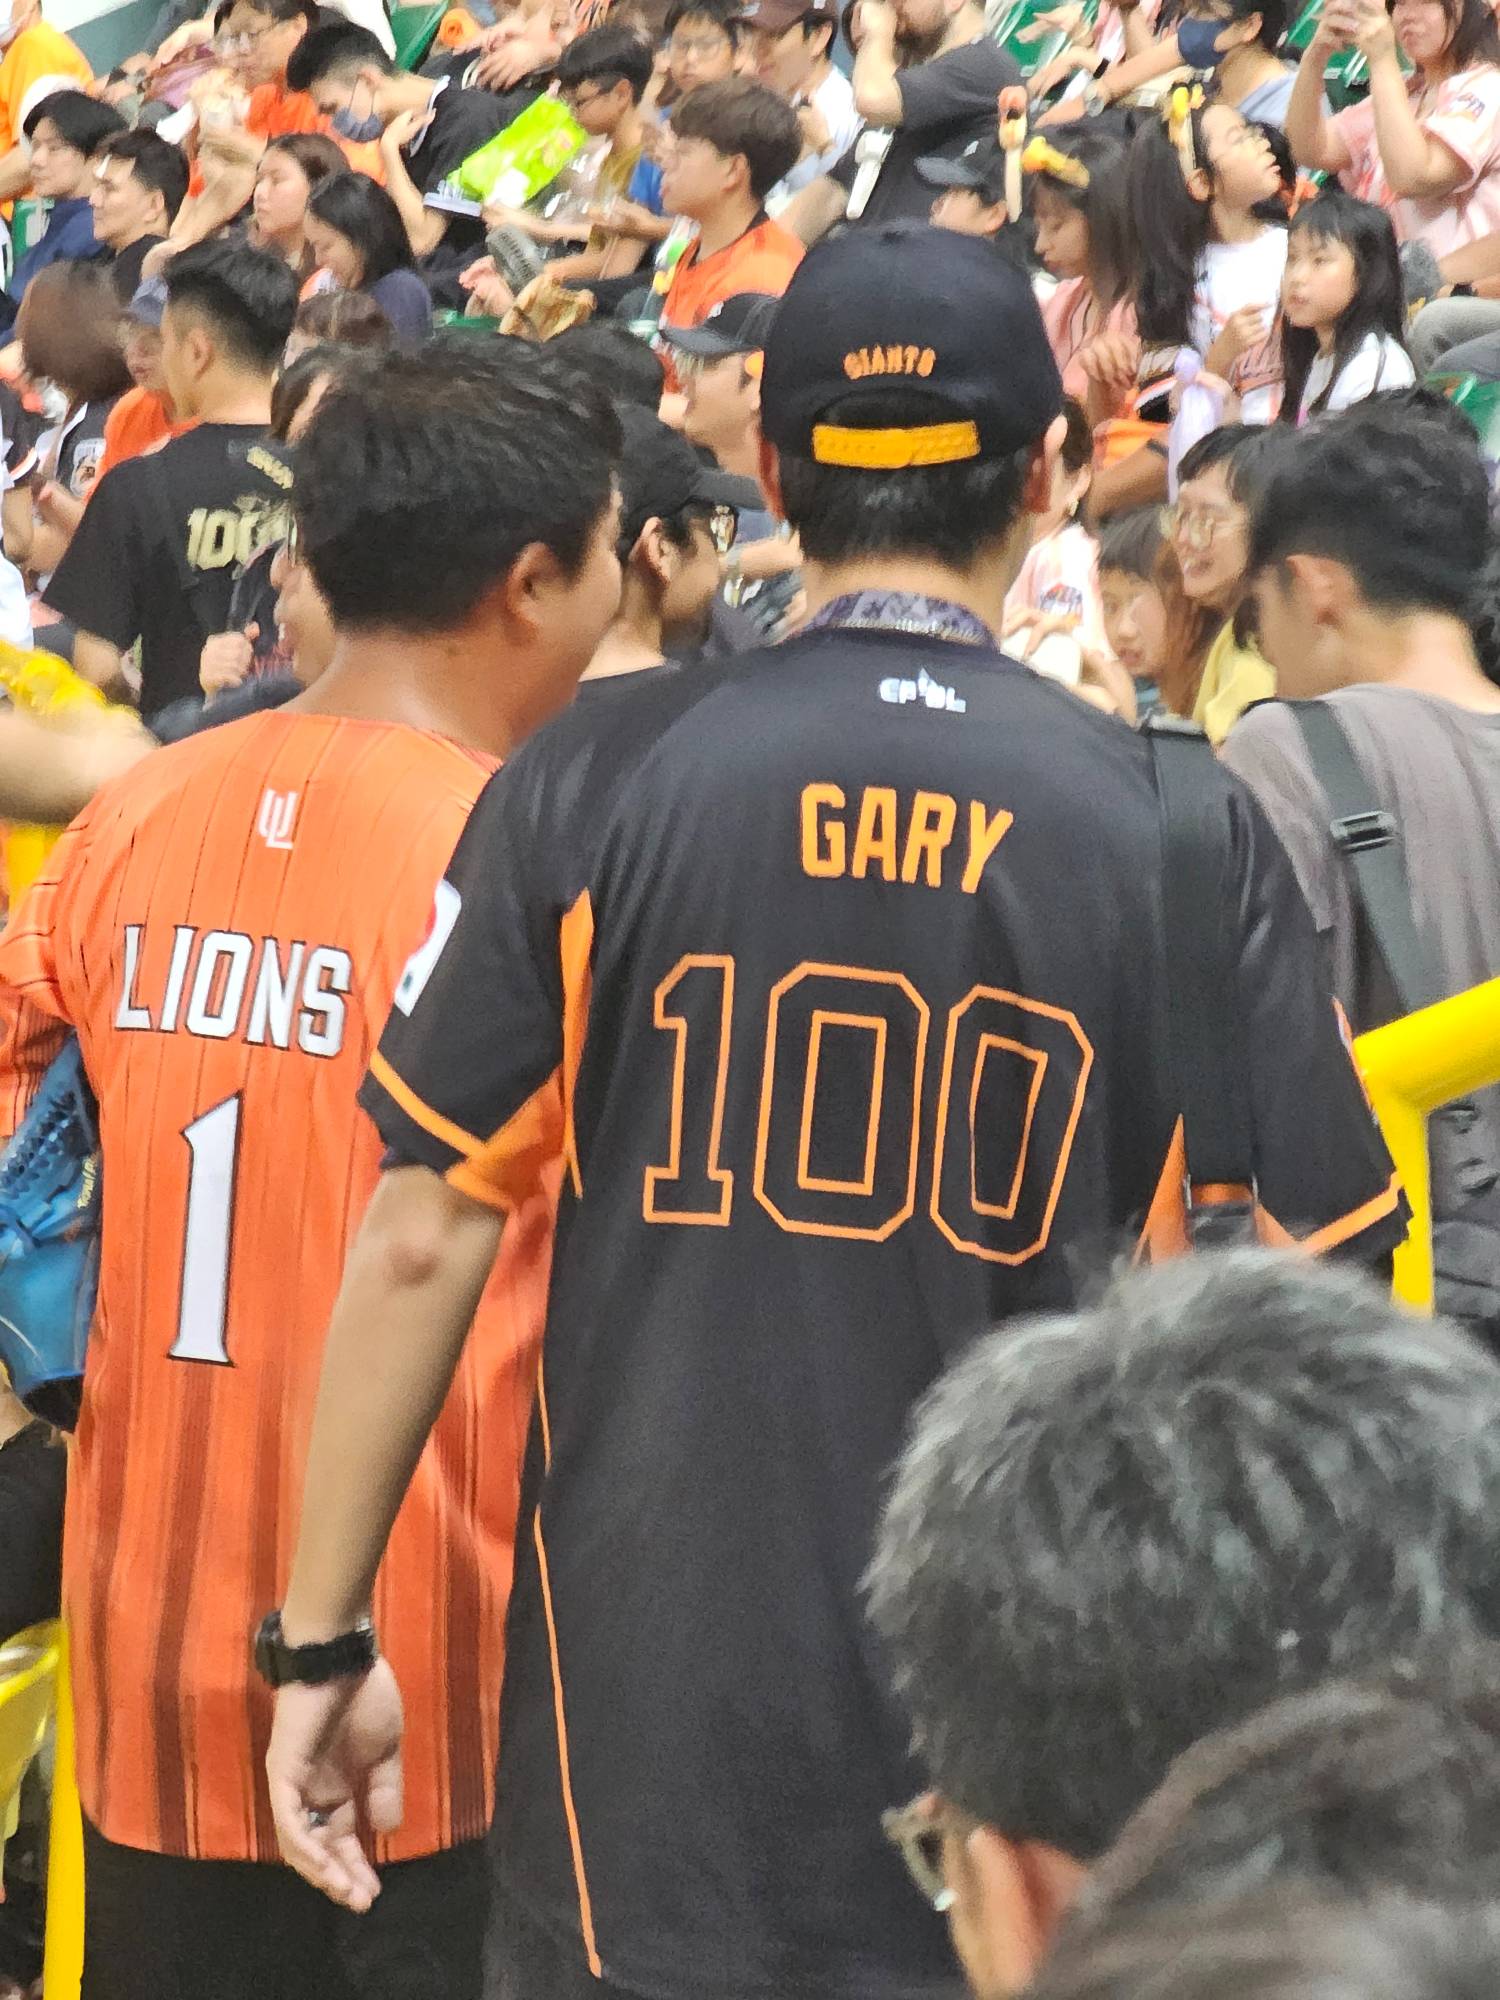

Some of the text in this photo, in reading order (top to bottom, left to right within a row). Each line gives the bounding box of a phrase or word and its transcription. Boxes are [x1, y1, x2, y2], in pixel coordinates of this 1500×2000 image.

[843, 345, 937, 380] GIANTS
[799, 782, 1014, 894] GARY
[114, 923, 353, 1058] LIONS
[642, 953, 1095, 1266] 100
[168, 1092, 244, 1367] 1
